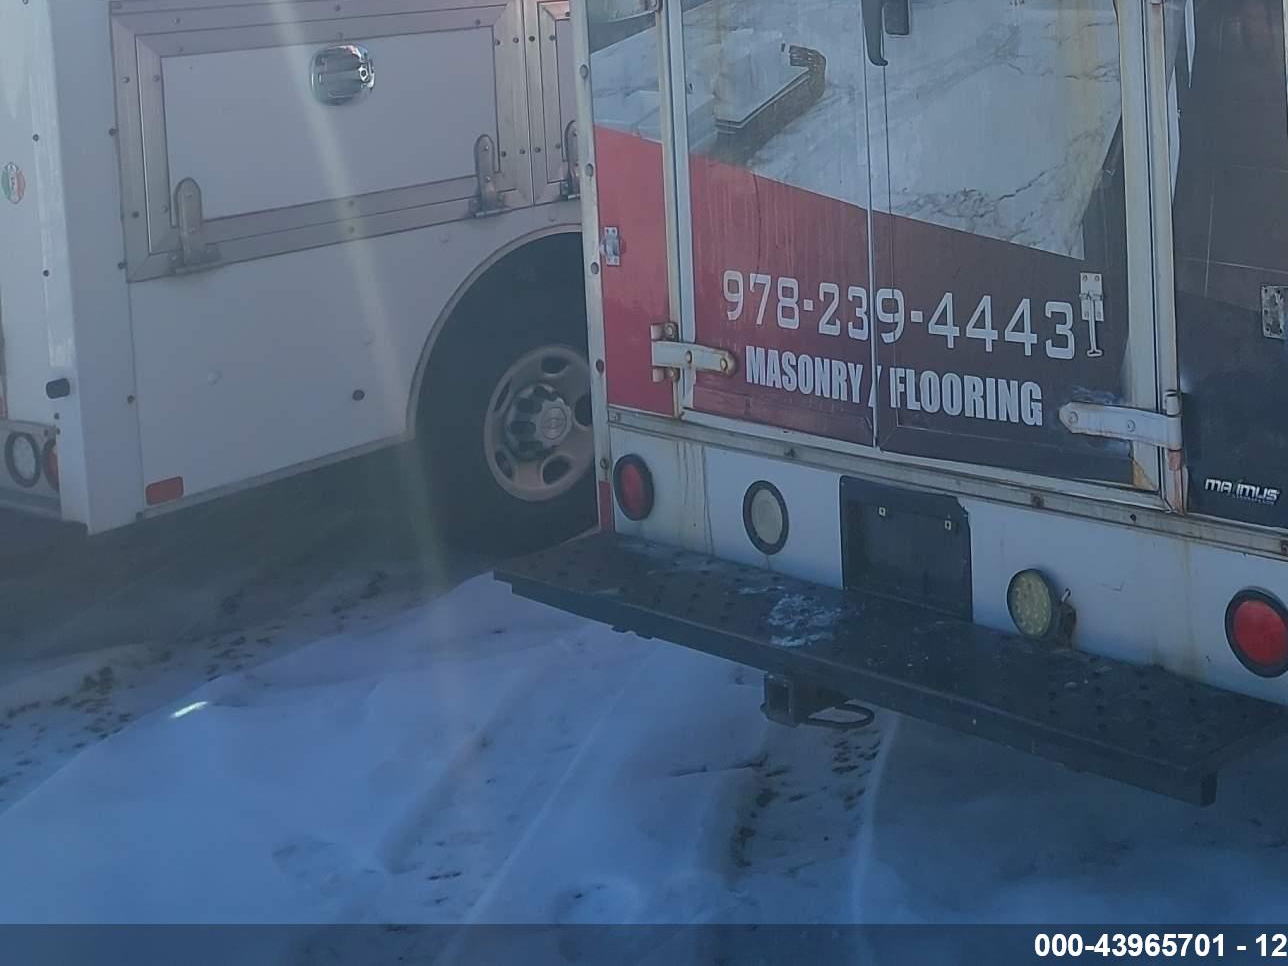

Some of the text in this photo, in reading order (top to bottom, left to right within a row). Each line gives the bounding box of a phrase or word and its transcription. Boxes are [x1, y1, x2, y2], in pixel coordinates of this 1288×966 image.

[722, 268, 1076, 360] 978-239-4443
[745, 345, 864, 404] MASONRY
[889, 367, 1043, 427] FLOORING
[1204, 477, 1280, 502] MAIMUS
